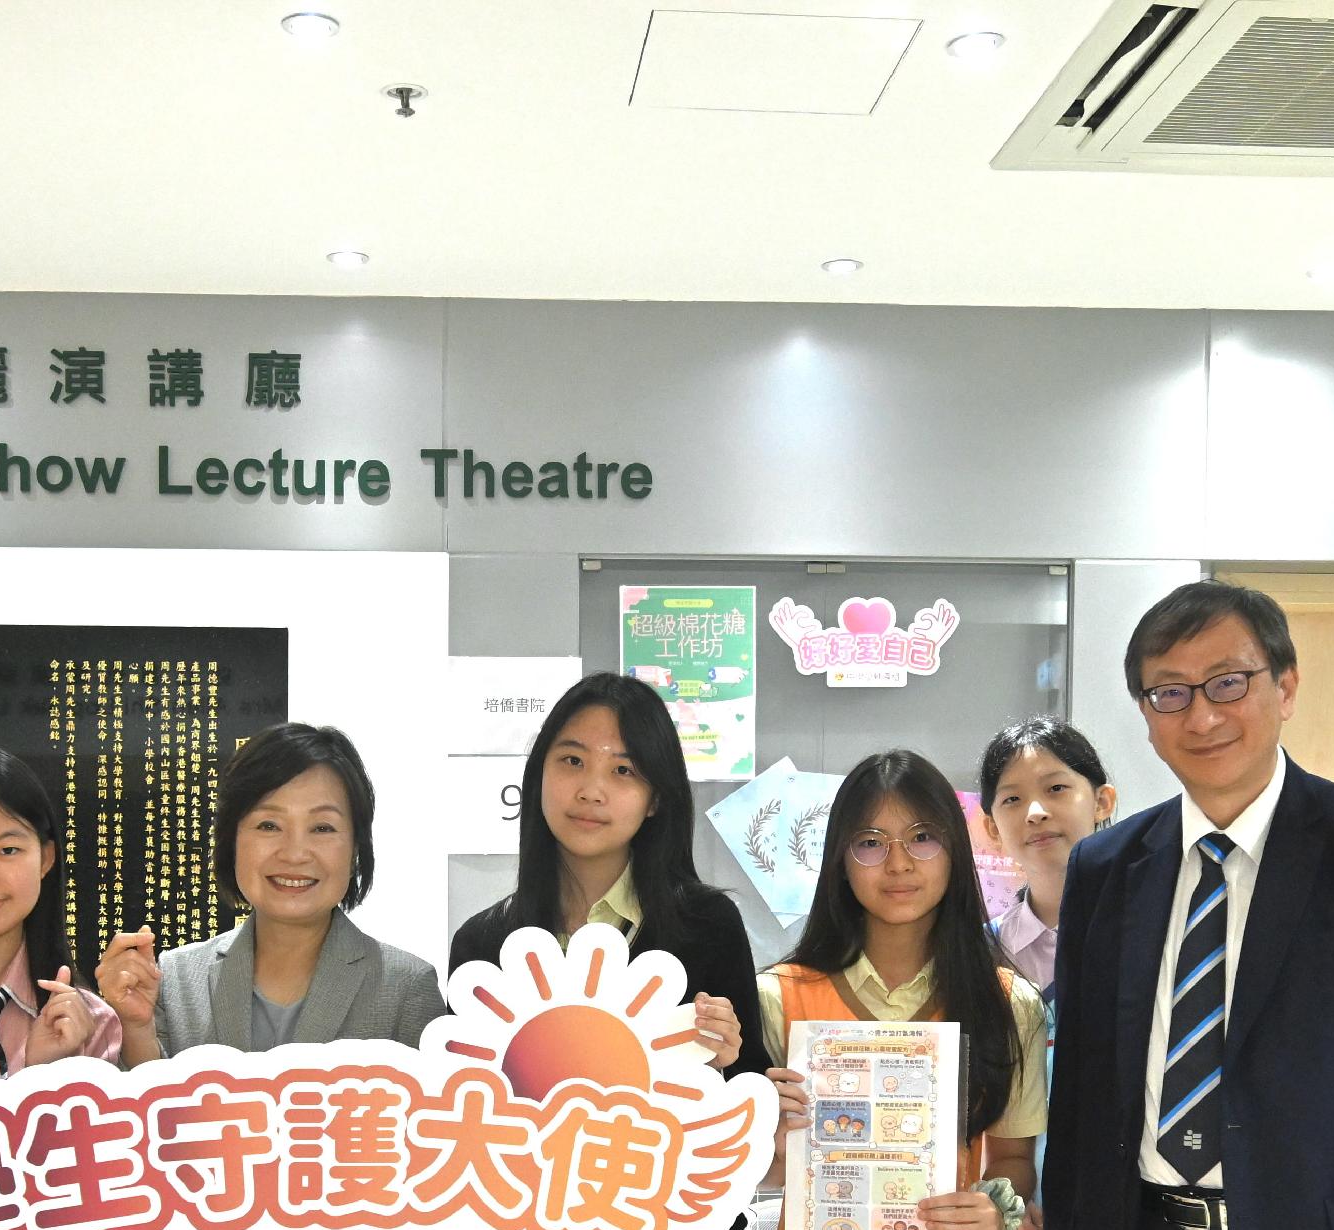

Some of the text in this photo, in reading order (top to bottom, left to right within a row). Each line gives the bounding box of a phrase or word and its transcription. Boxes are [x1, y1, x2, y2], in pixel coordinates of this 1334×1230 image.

[158, 446, 391, 500] Lecture
[420, 448, 654, 500] Theatre
[632, 612, 746, 637] 超級棉花糖
[654, 635, 724, 658] 工作坊
[801, 637, 935, 669] 好好愛自己
[483, 697, 546, 713] 培僑書院
